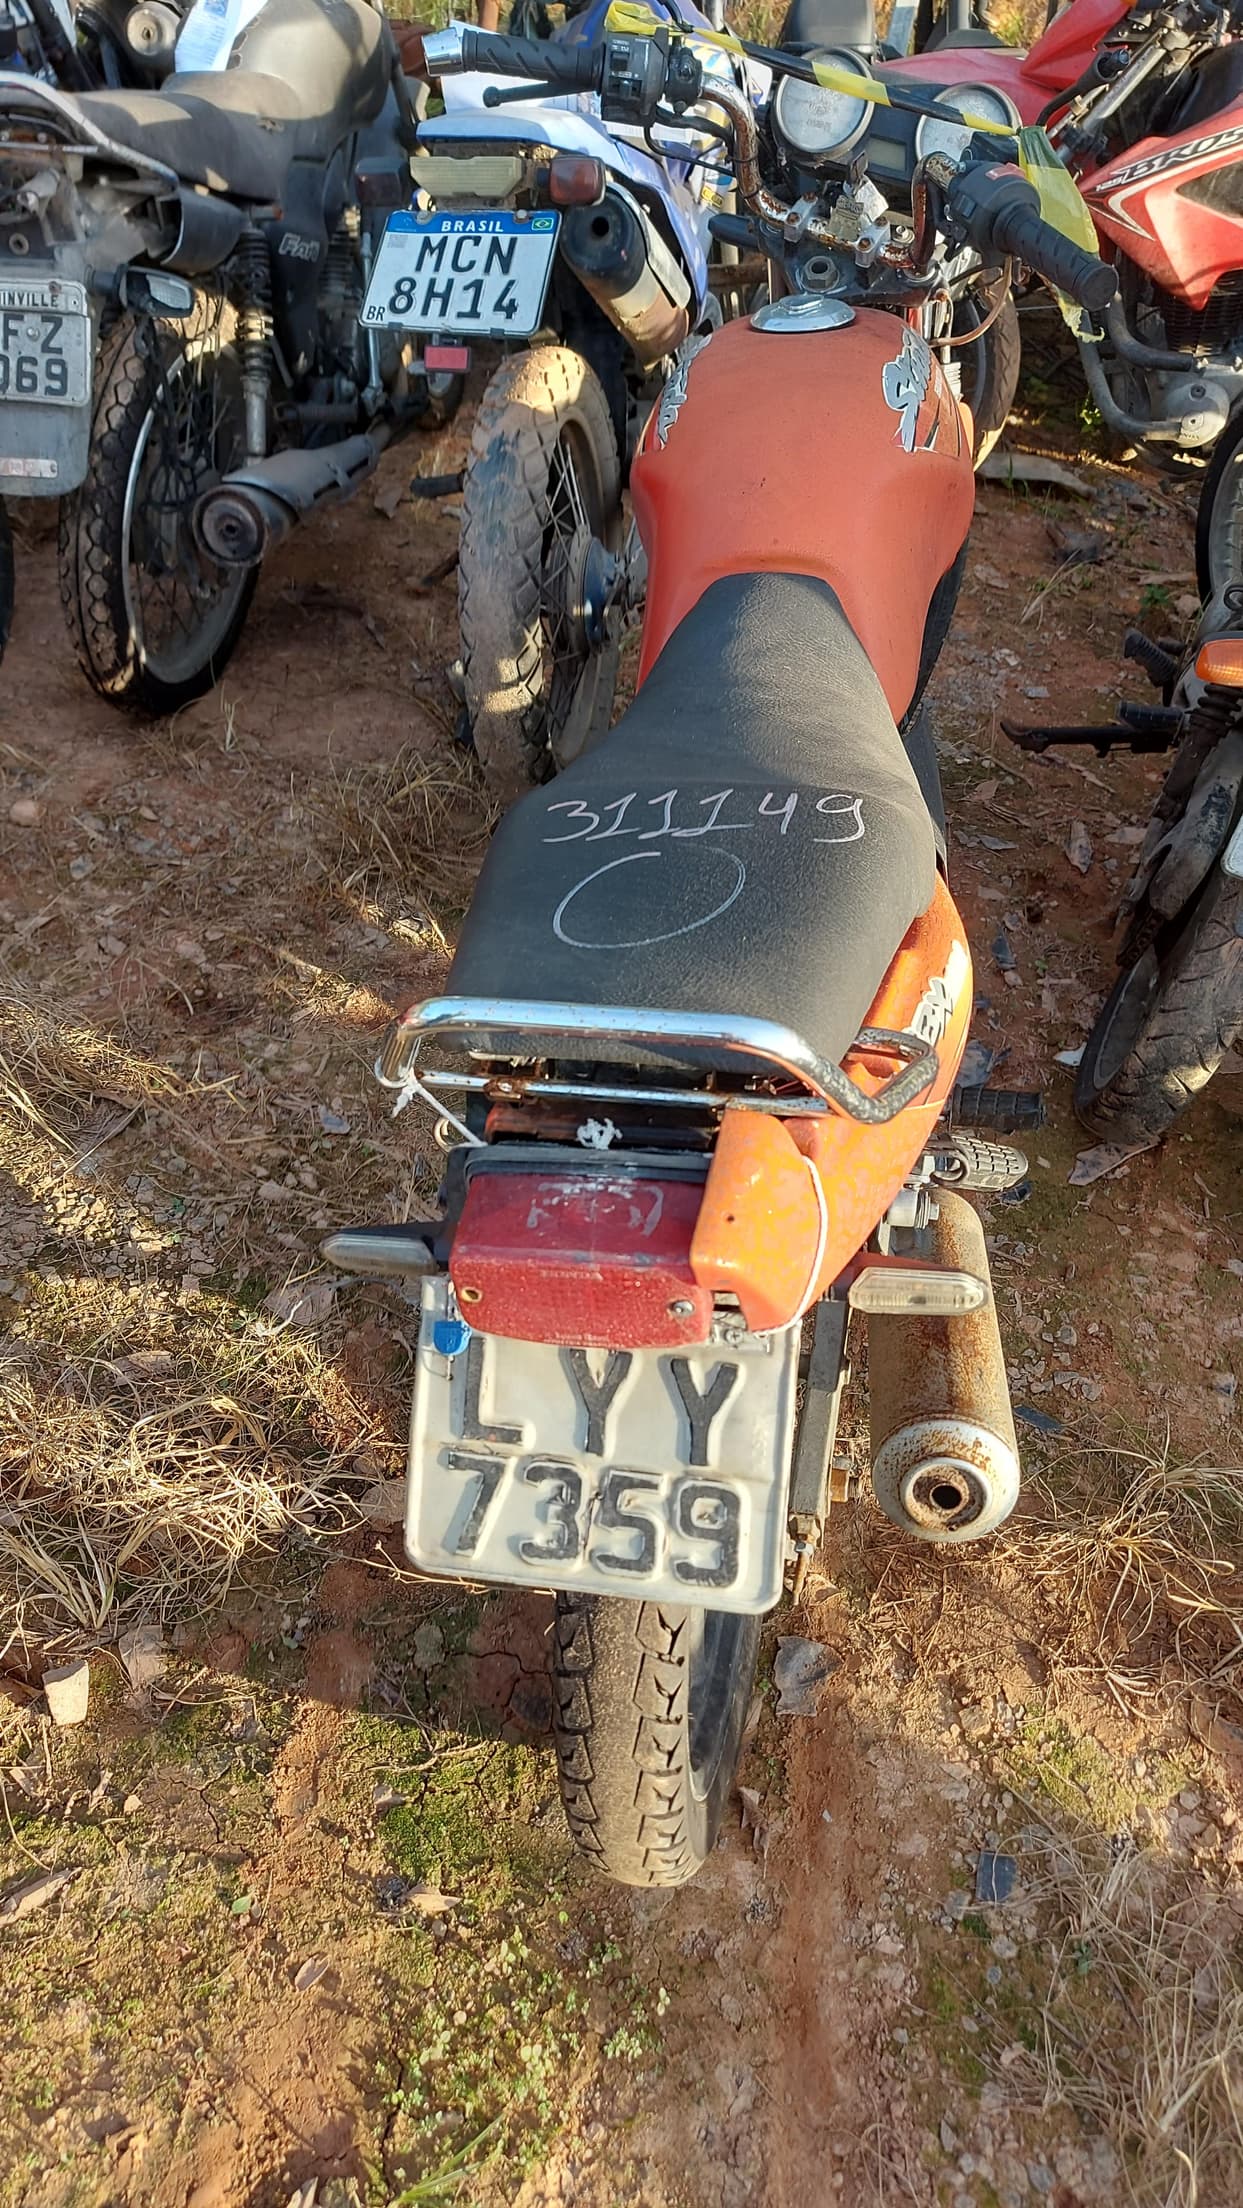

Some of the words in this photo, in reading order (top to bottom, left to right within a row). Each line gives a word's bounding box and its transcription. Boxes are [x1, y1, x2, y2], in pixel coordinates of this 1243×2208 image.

[441, 220, 504, 232] BRASIL
[415, 235, 518, 276] MCN
[366, 306, 385, 321] BR
[388, 276, 518, 320] 8H14
[542, 788, 865, 843] 311149
[462, 1336, 738, 1466] LYY
[448, 1453, 741, 1587] 7359
